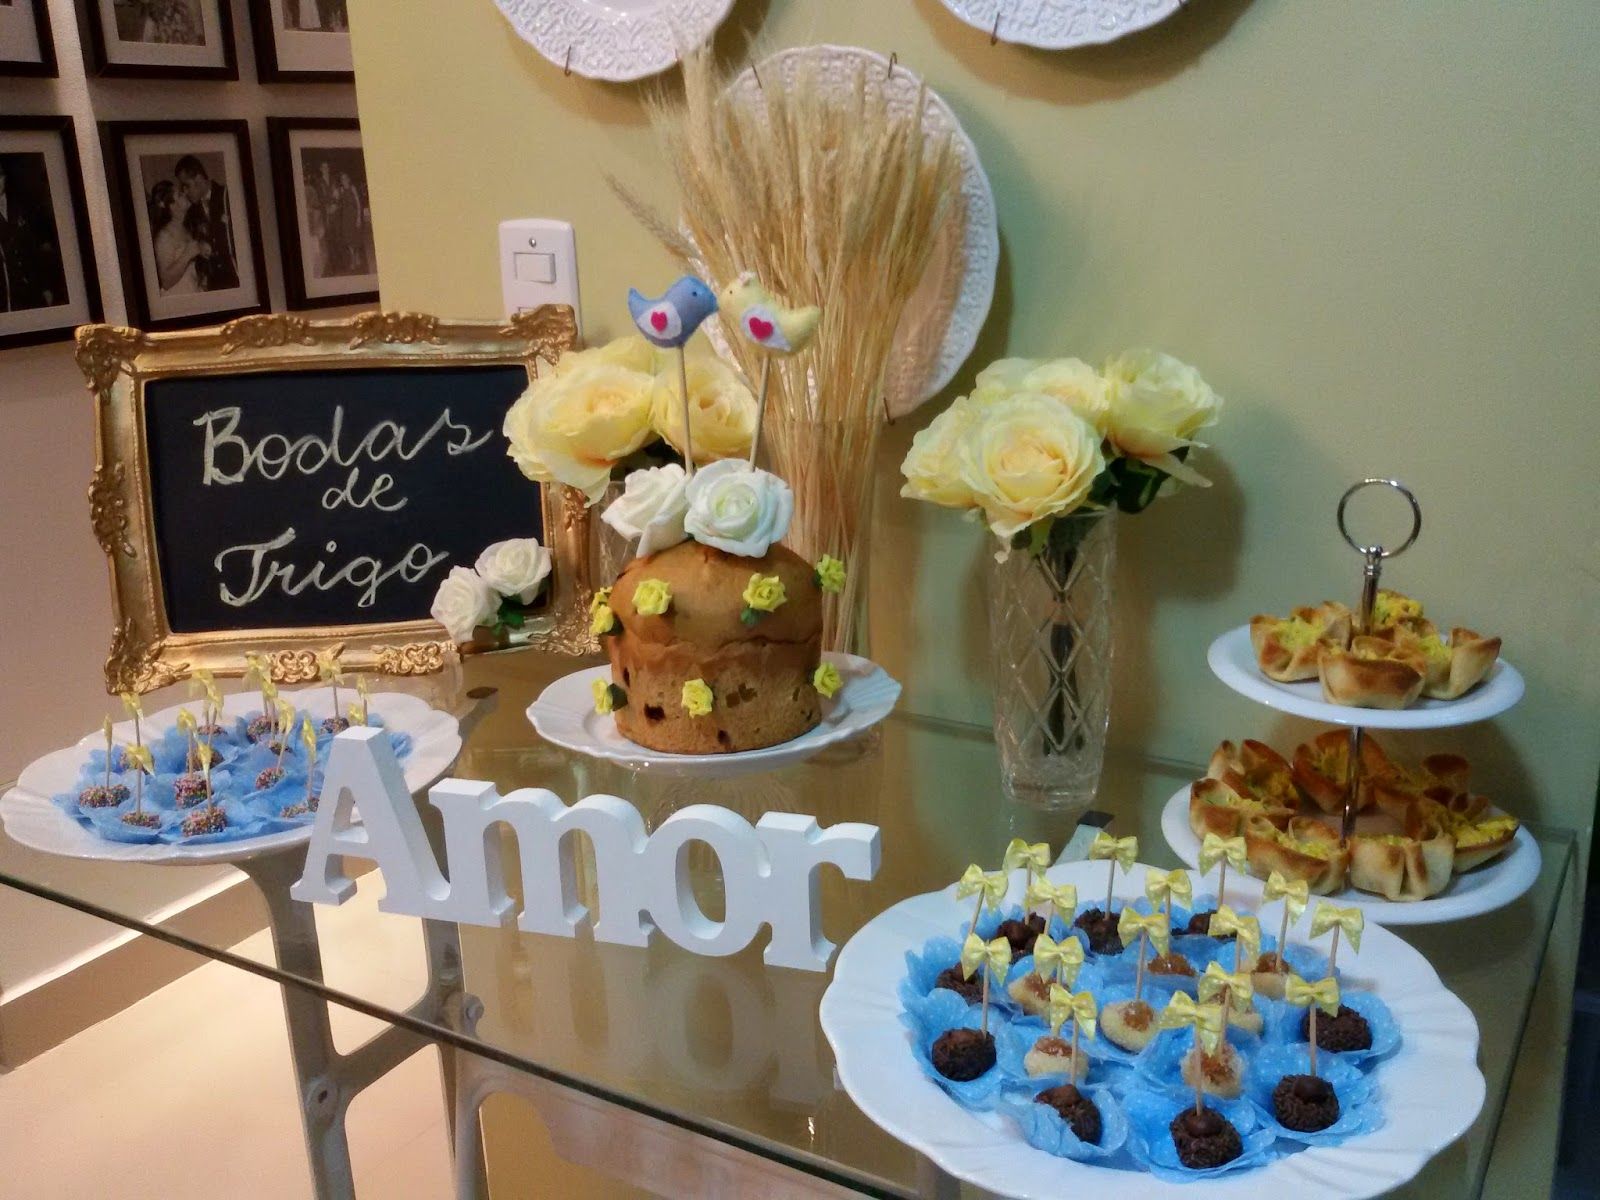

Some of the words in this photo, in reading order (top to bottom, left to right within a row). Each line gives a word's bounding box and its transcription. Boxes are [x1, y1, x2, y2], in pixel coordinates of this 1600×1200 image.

[192, 405, 493, 485] Bodas
[321, 467, 409, 513] de
[213, 526, 449, 607] Trigo
[290, 725, 882, 972] Amor
